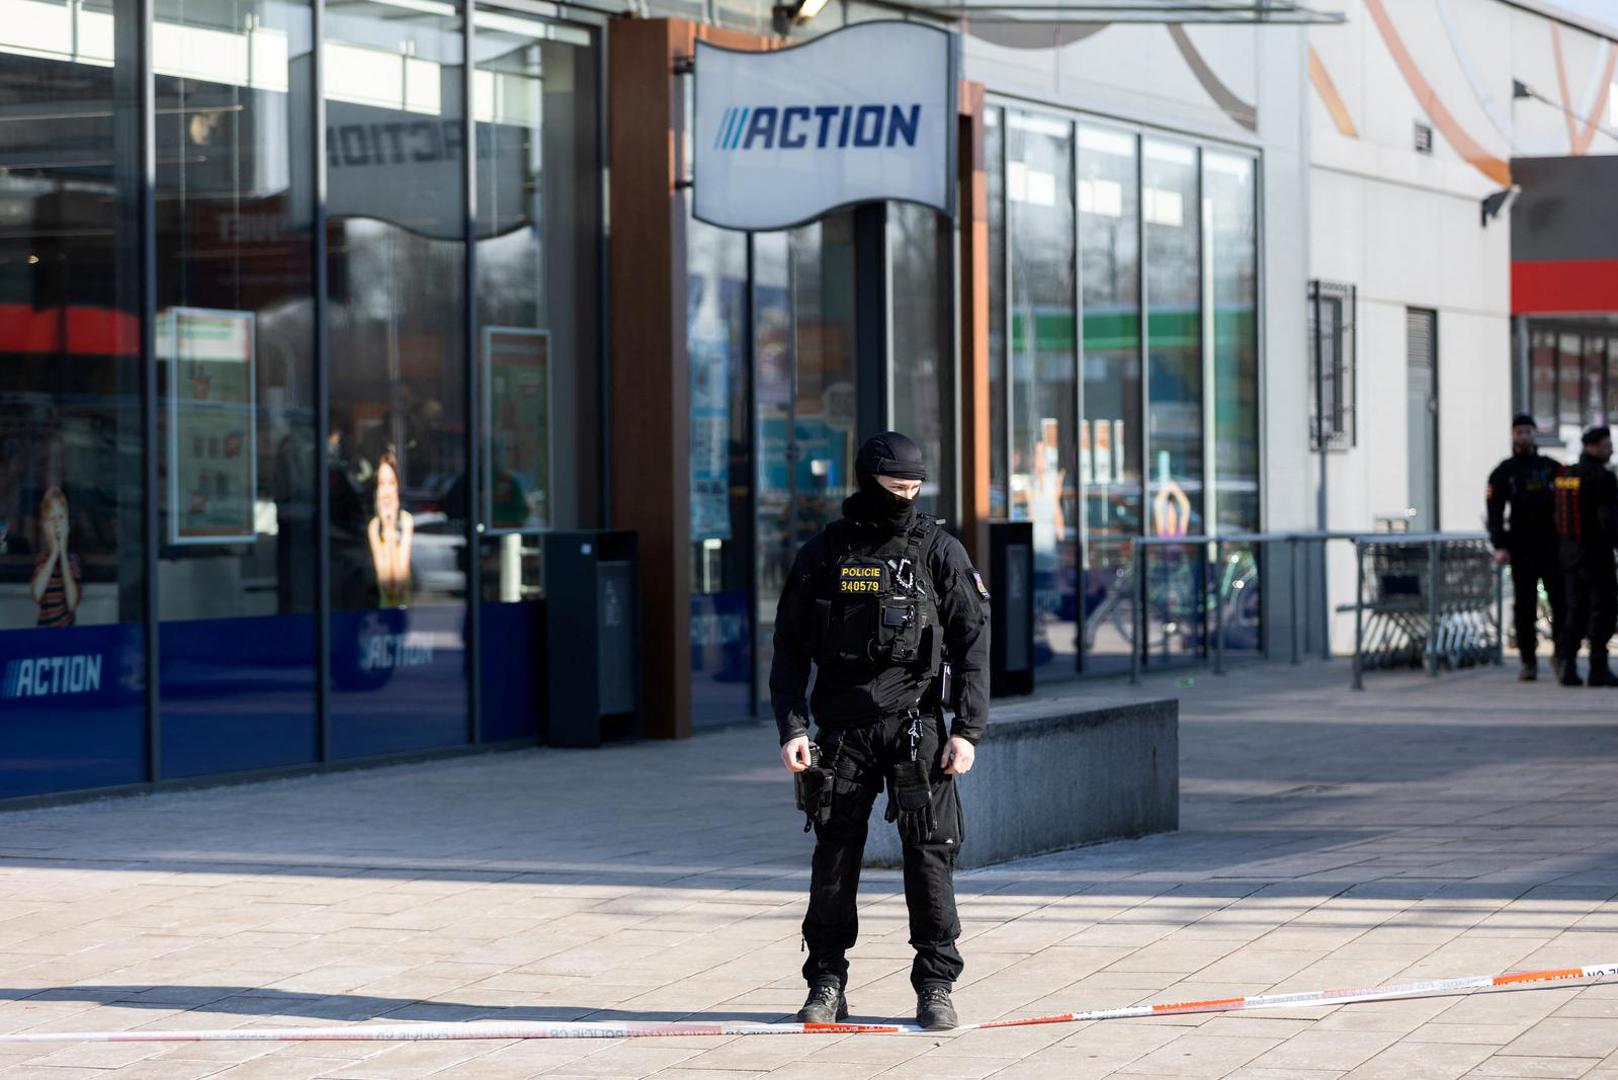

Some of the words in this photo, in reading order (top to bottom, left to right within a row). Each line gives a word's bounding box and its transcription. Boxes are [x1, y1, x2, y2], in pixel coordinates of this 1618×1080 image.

[742, 104, 921, 149] ACTION
[842, 567, 881, 577] POLICIE
[841, 581, 879, 592] 340579
[16, 654, 103, 698] ACTION
